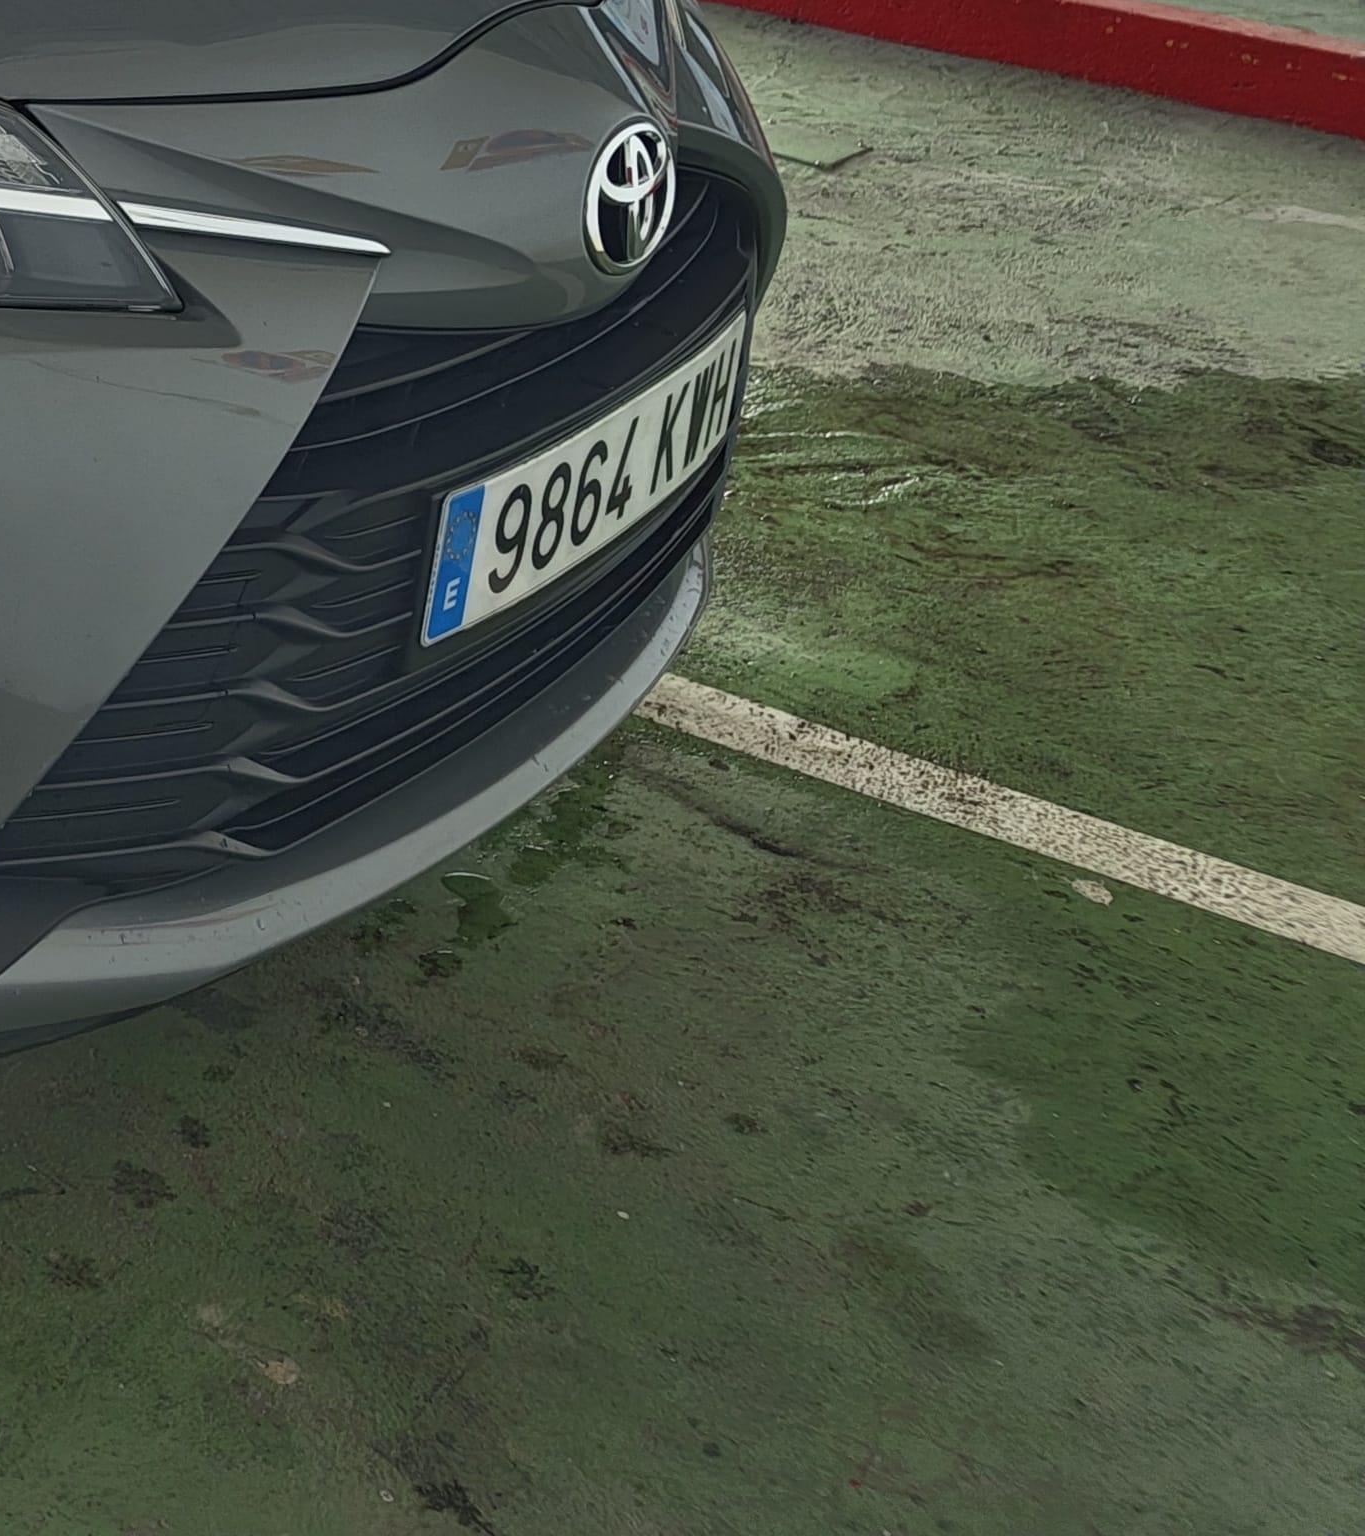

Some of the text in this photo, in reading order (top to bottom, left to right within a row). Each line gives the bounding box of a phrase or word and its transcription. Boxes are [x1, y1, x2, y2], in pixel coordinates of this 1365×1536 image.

[487, 337, 737, 595] 9864 KWH
[442, 575, 462, 612] E
